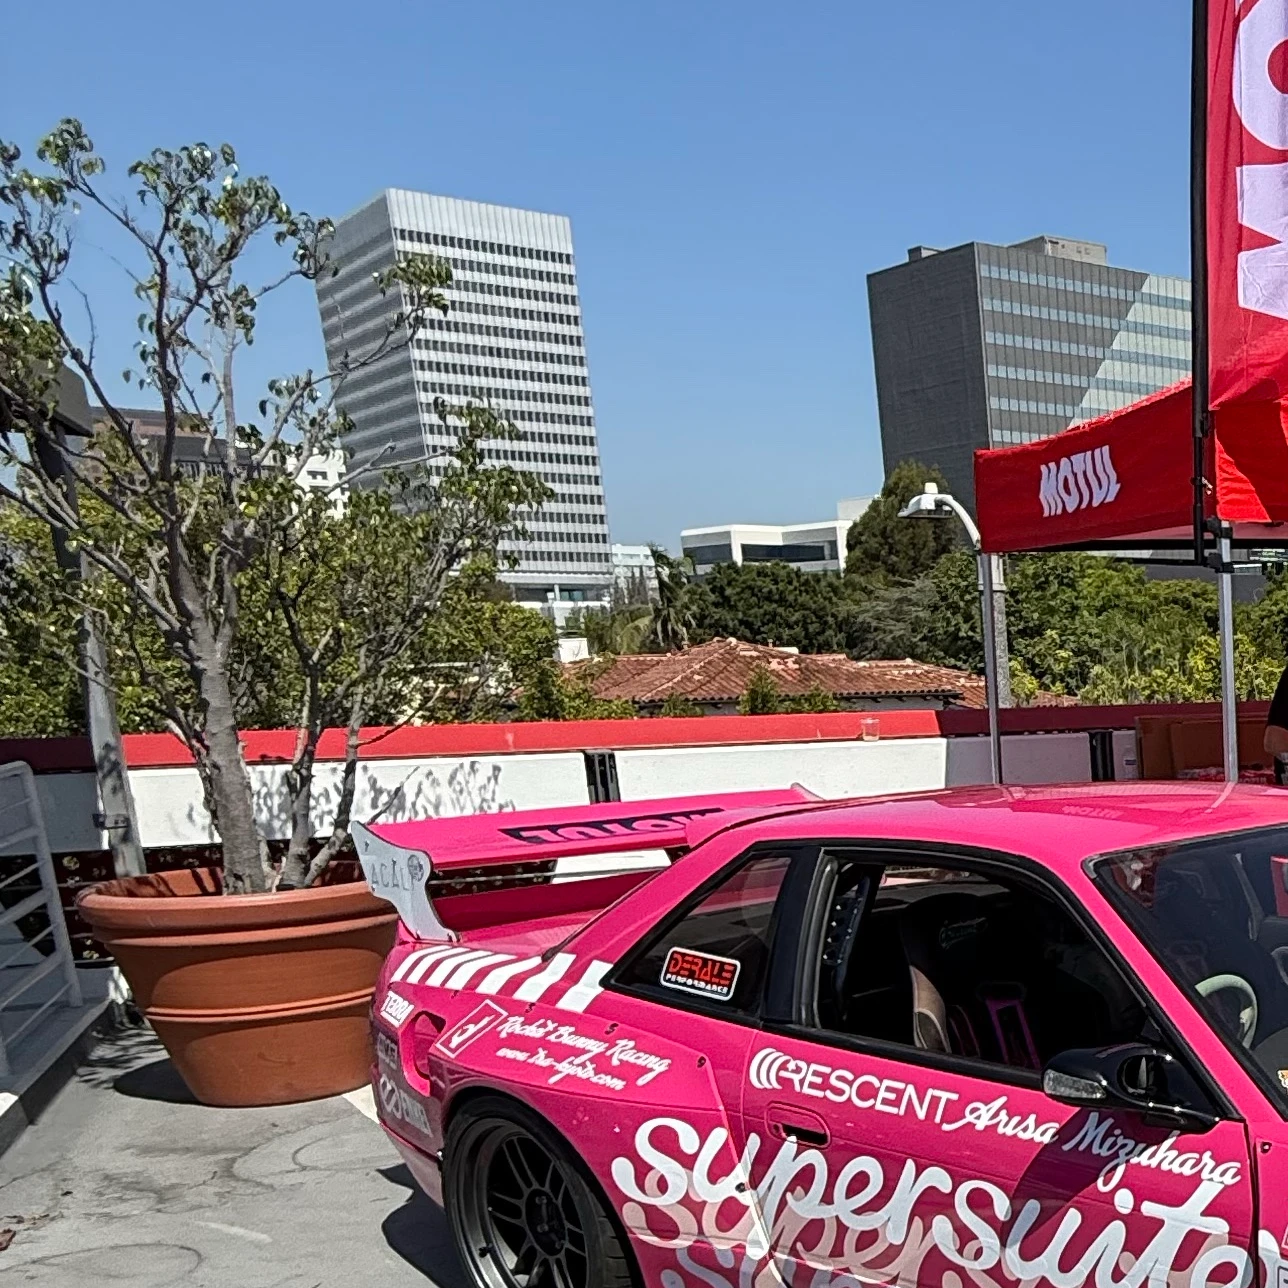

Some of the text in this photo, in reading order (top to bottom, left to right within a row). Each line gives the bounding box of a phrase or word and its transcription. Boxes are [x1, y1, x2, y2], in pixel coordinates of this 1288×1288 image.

[1039, 445, 1121, 518] MOTUL
[668, 953, 735, 986] DERALE
[496, 1015, 673, 1087] Rocket Bunny Racing
[941, 1097, 1059, 1144] Arisa
[1062, 1111, 1242, 1192] Mizuhara
